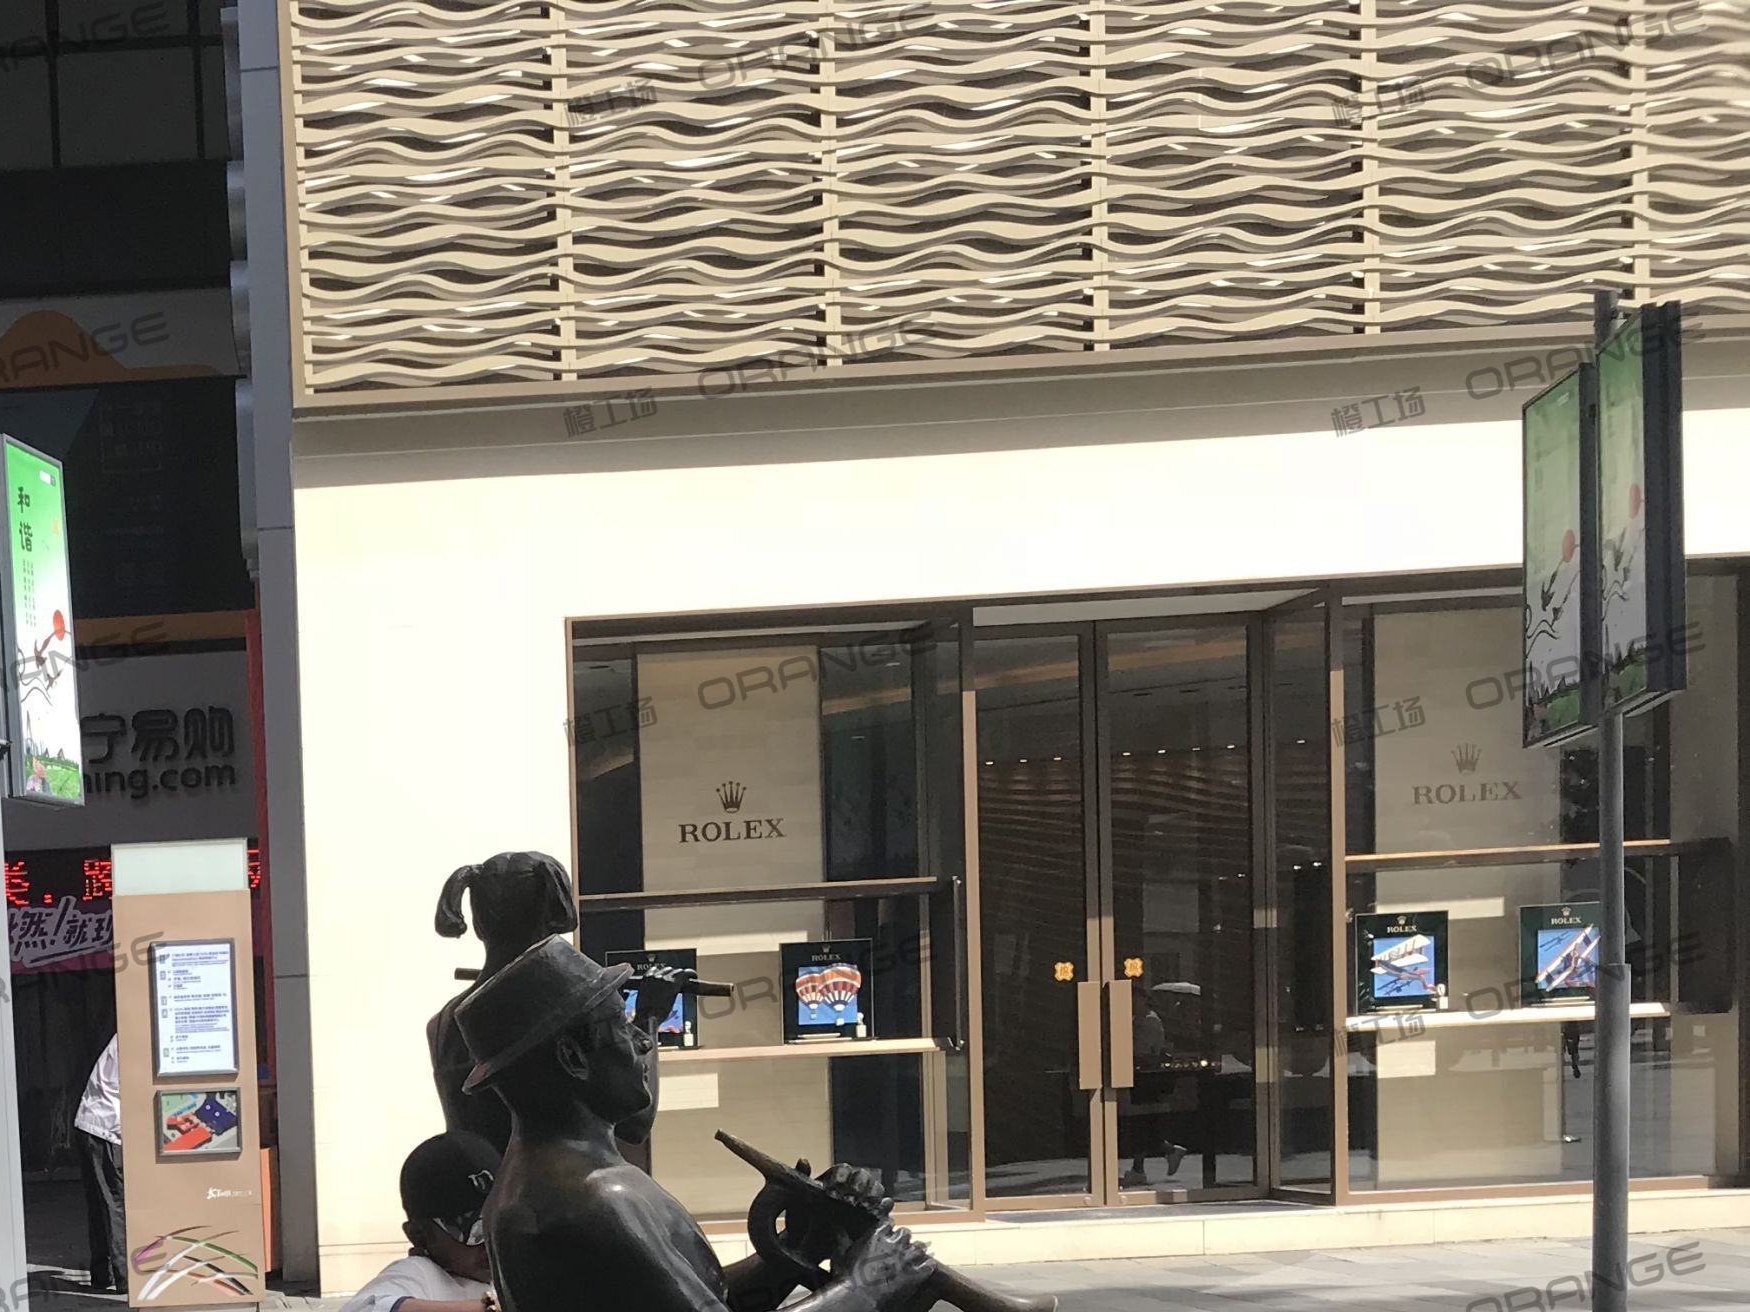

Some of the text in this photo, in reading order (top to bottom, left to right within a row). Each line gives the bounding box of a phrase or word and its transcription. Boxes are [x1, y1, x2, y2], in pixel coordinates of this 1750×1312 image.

[17, 486, 34, 552] 和谐
[1412, 780, 1522, 805] ROLEX
[678, 818, 787, 843] ROLEX
[1386, 924, 1418, 934] ROLEX
[1551, 916, 1582, 925] ROLEX
[811, 953, 842, 962] ROLEX
